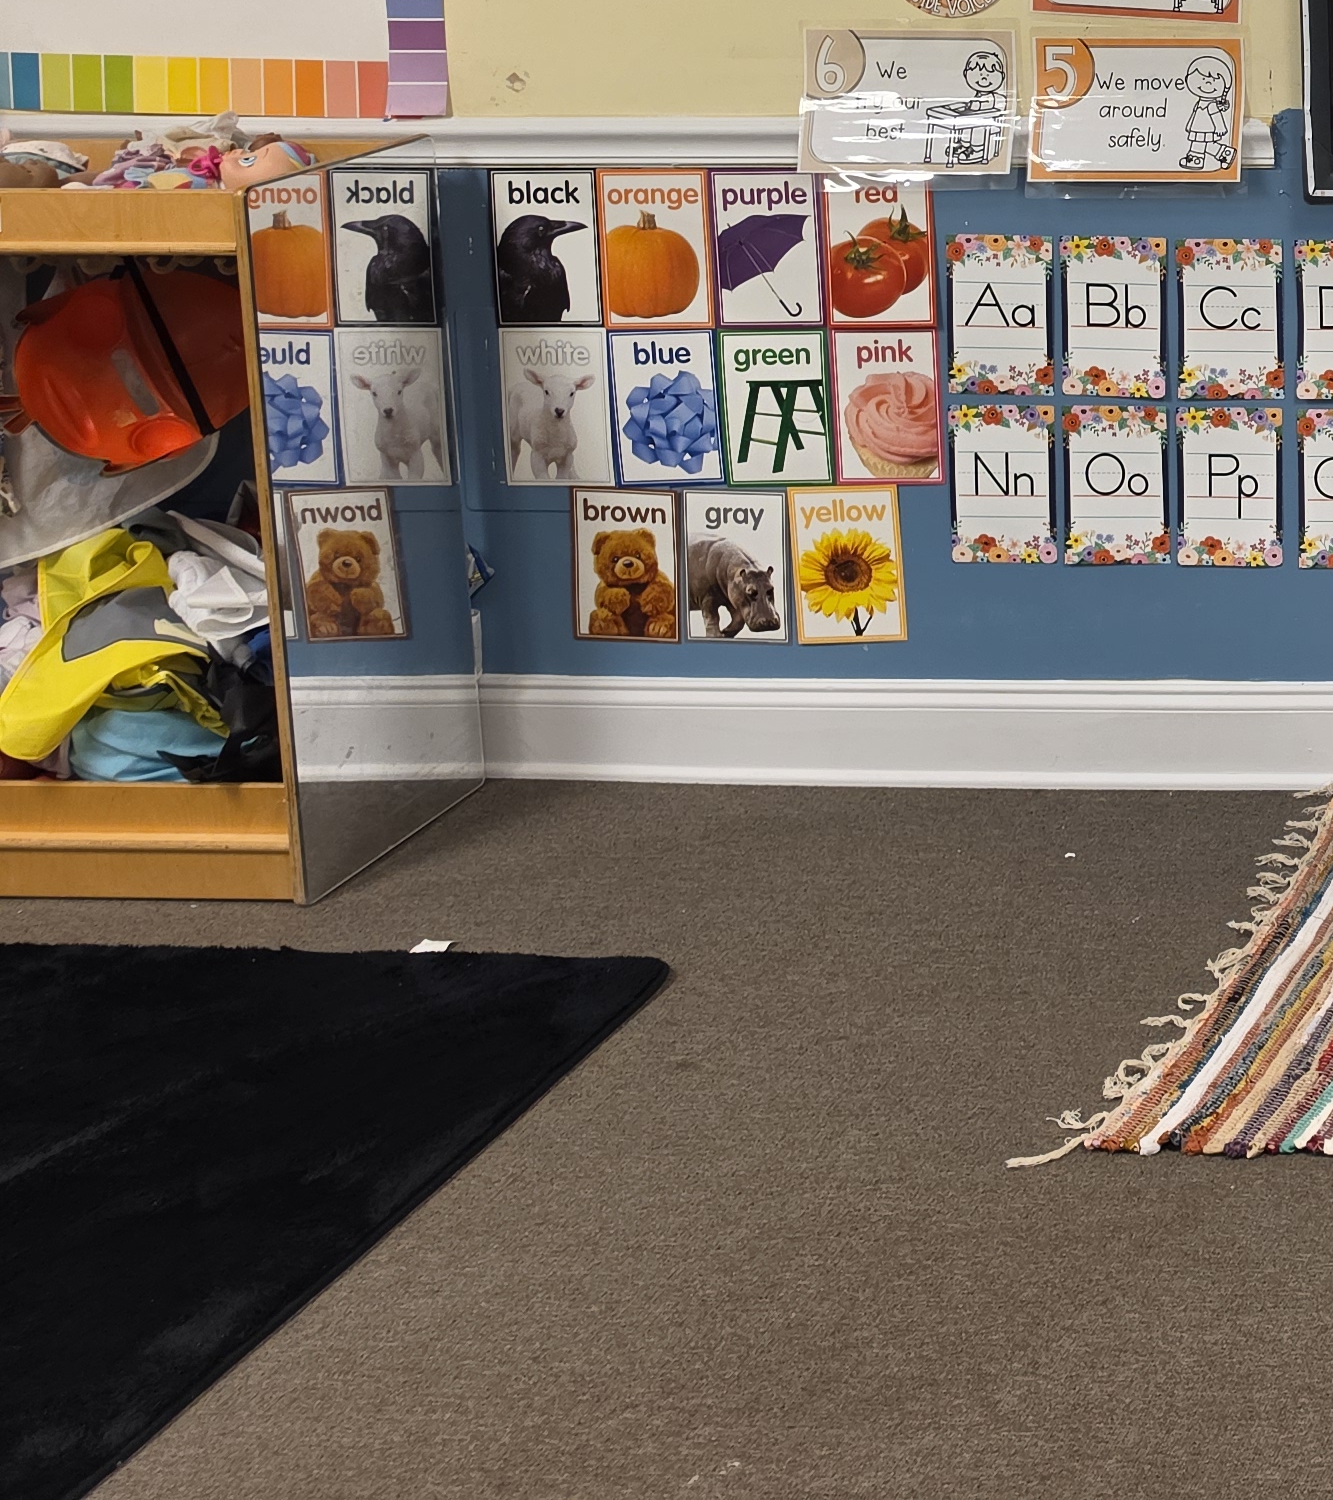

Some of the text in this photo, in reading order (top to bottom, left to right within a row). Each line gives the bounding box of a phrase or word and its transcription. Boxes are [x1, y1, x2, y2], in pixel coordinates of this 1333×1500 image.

[1043, 45, 1076, 101] 5
[1095, 72, 1185, 92] We move
[1099, 99, 1167, 120] around
[1107, 129, 1166, 156] safely.
[507, 180, 580, 205] black
[607, 185, 699, 212] orange
[721, 183, 808, 213] purple
[854, 181, 898, 204] red
[965, 282, 1036, 328] Aa
[1085, 283, 1147, 329] Bb
[633, 340, 691, 366] blue
[733, 343, 811, 373] green
[856, 339, 913, 370] pink
[583, 496, 667, 525] brown
[704, 504, 765, 534] gray
[800, 499, 886, 529] yellow
